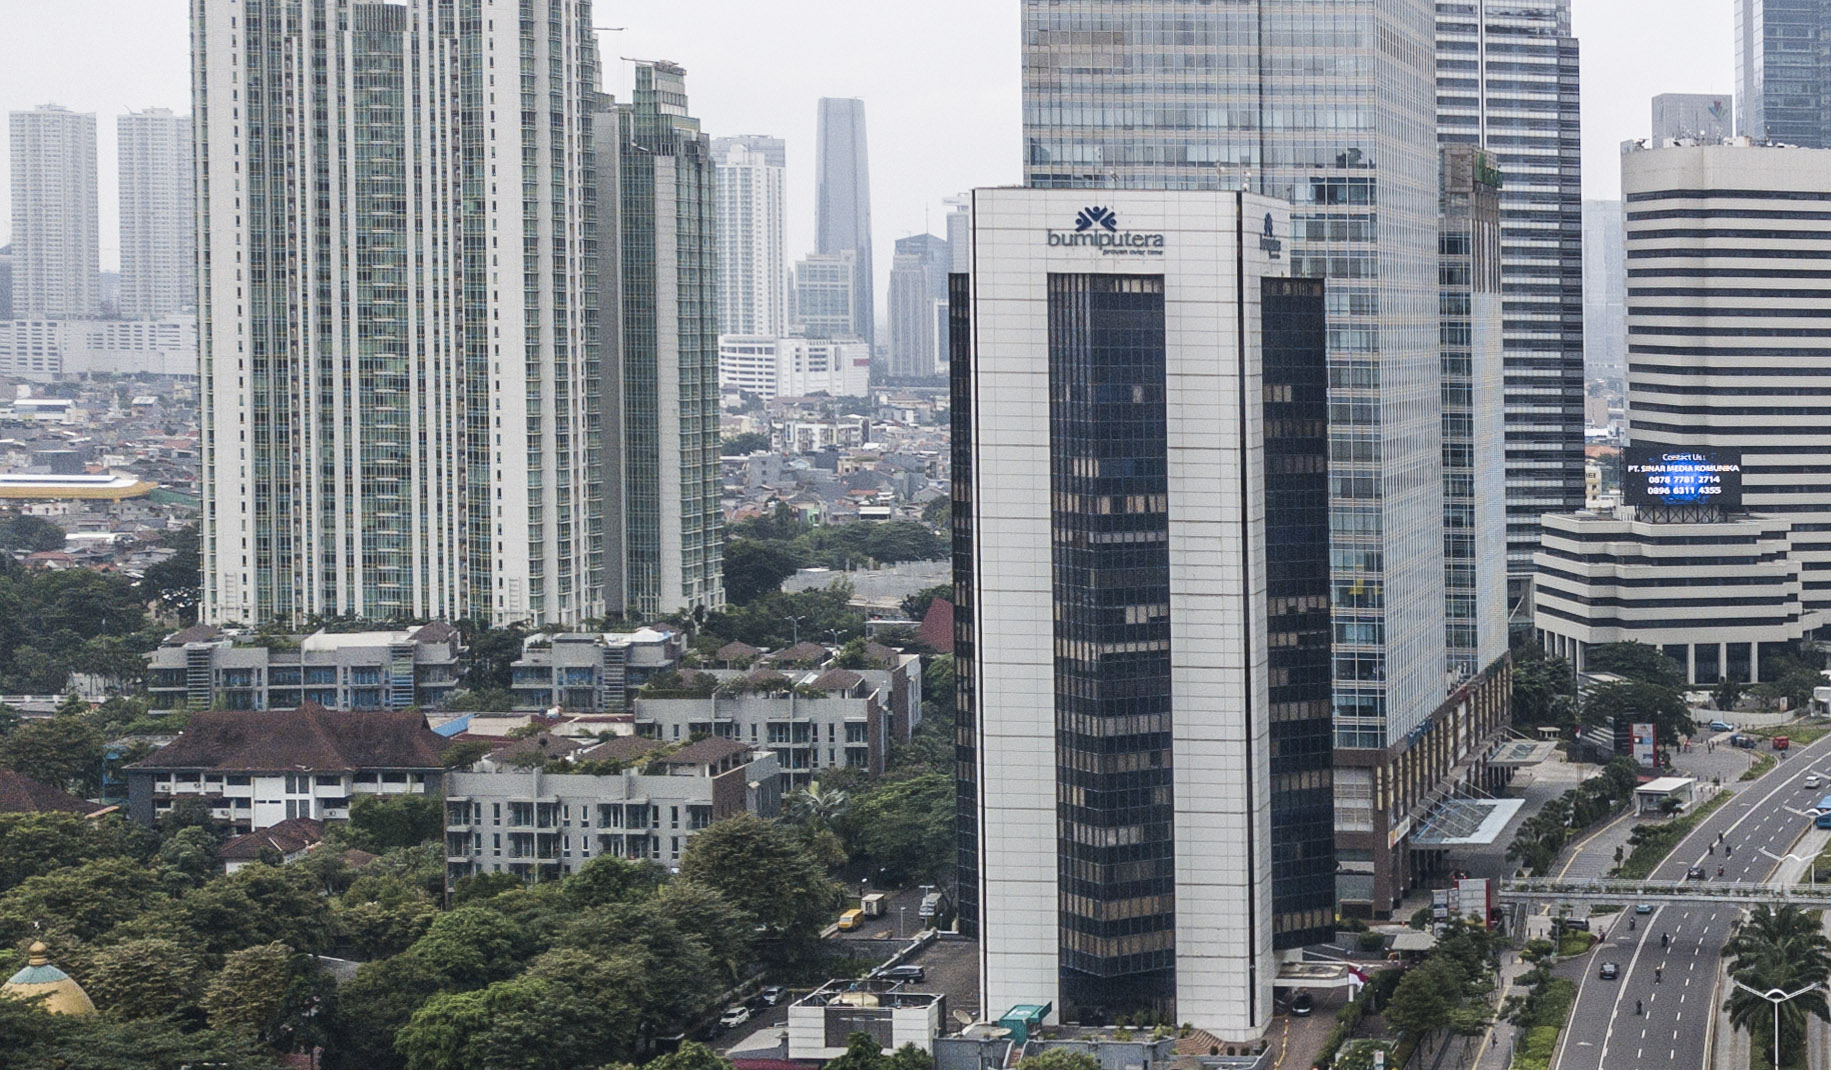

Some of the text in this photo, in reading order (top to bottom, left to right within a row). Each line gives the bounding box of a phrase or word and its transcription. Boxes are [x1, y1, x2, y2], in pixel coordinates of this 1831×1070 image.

[1047, 229, 1164, 250] bumiputera
[1662, 453, 1691, 461] Contact
[1667, 465, 1693, 473] MEDIA
[1698, 476, 1720, 484] 2714
[1673, 487, 1694, 495] 6311
